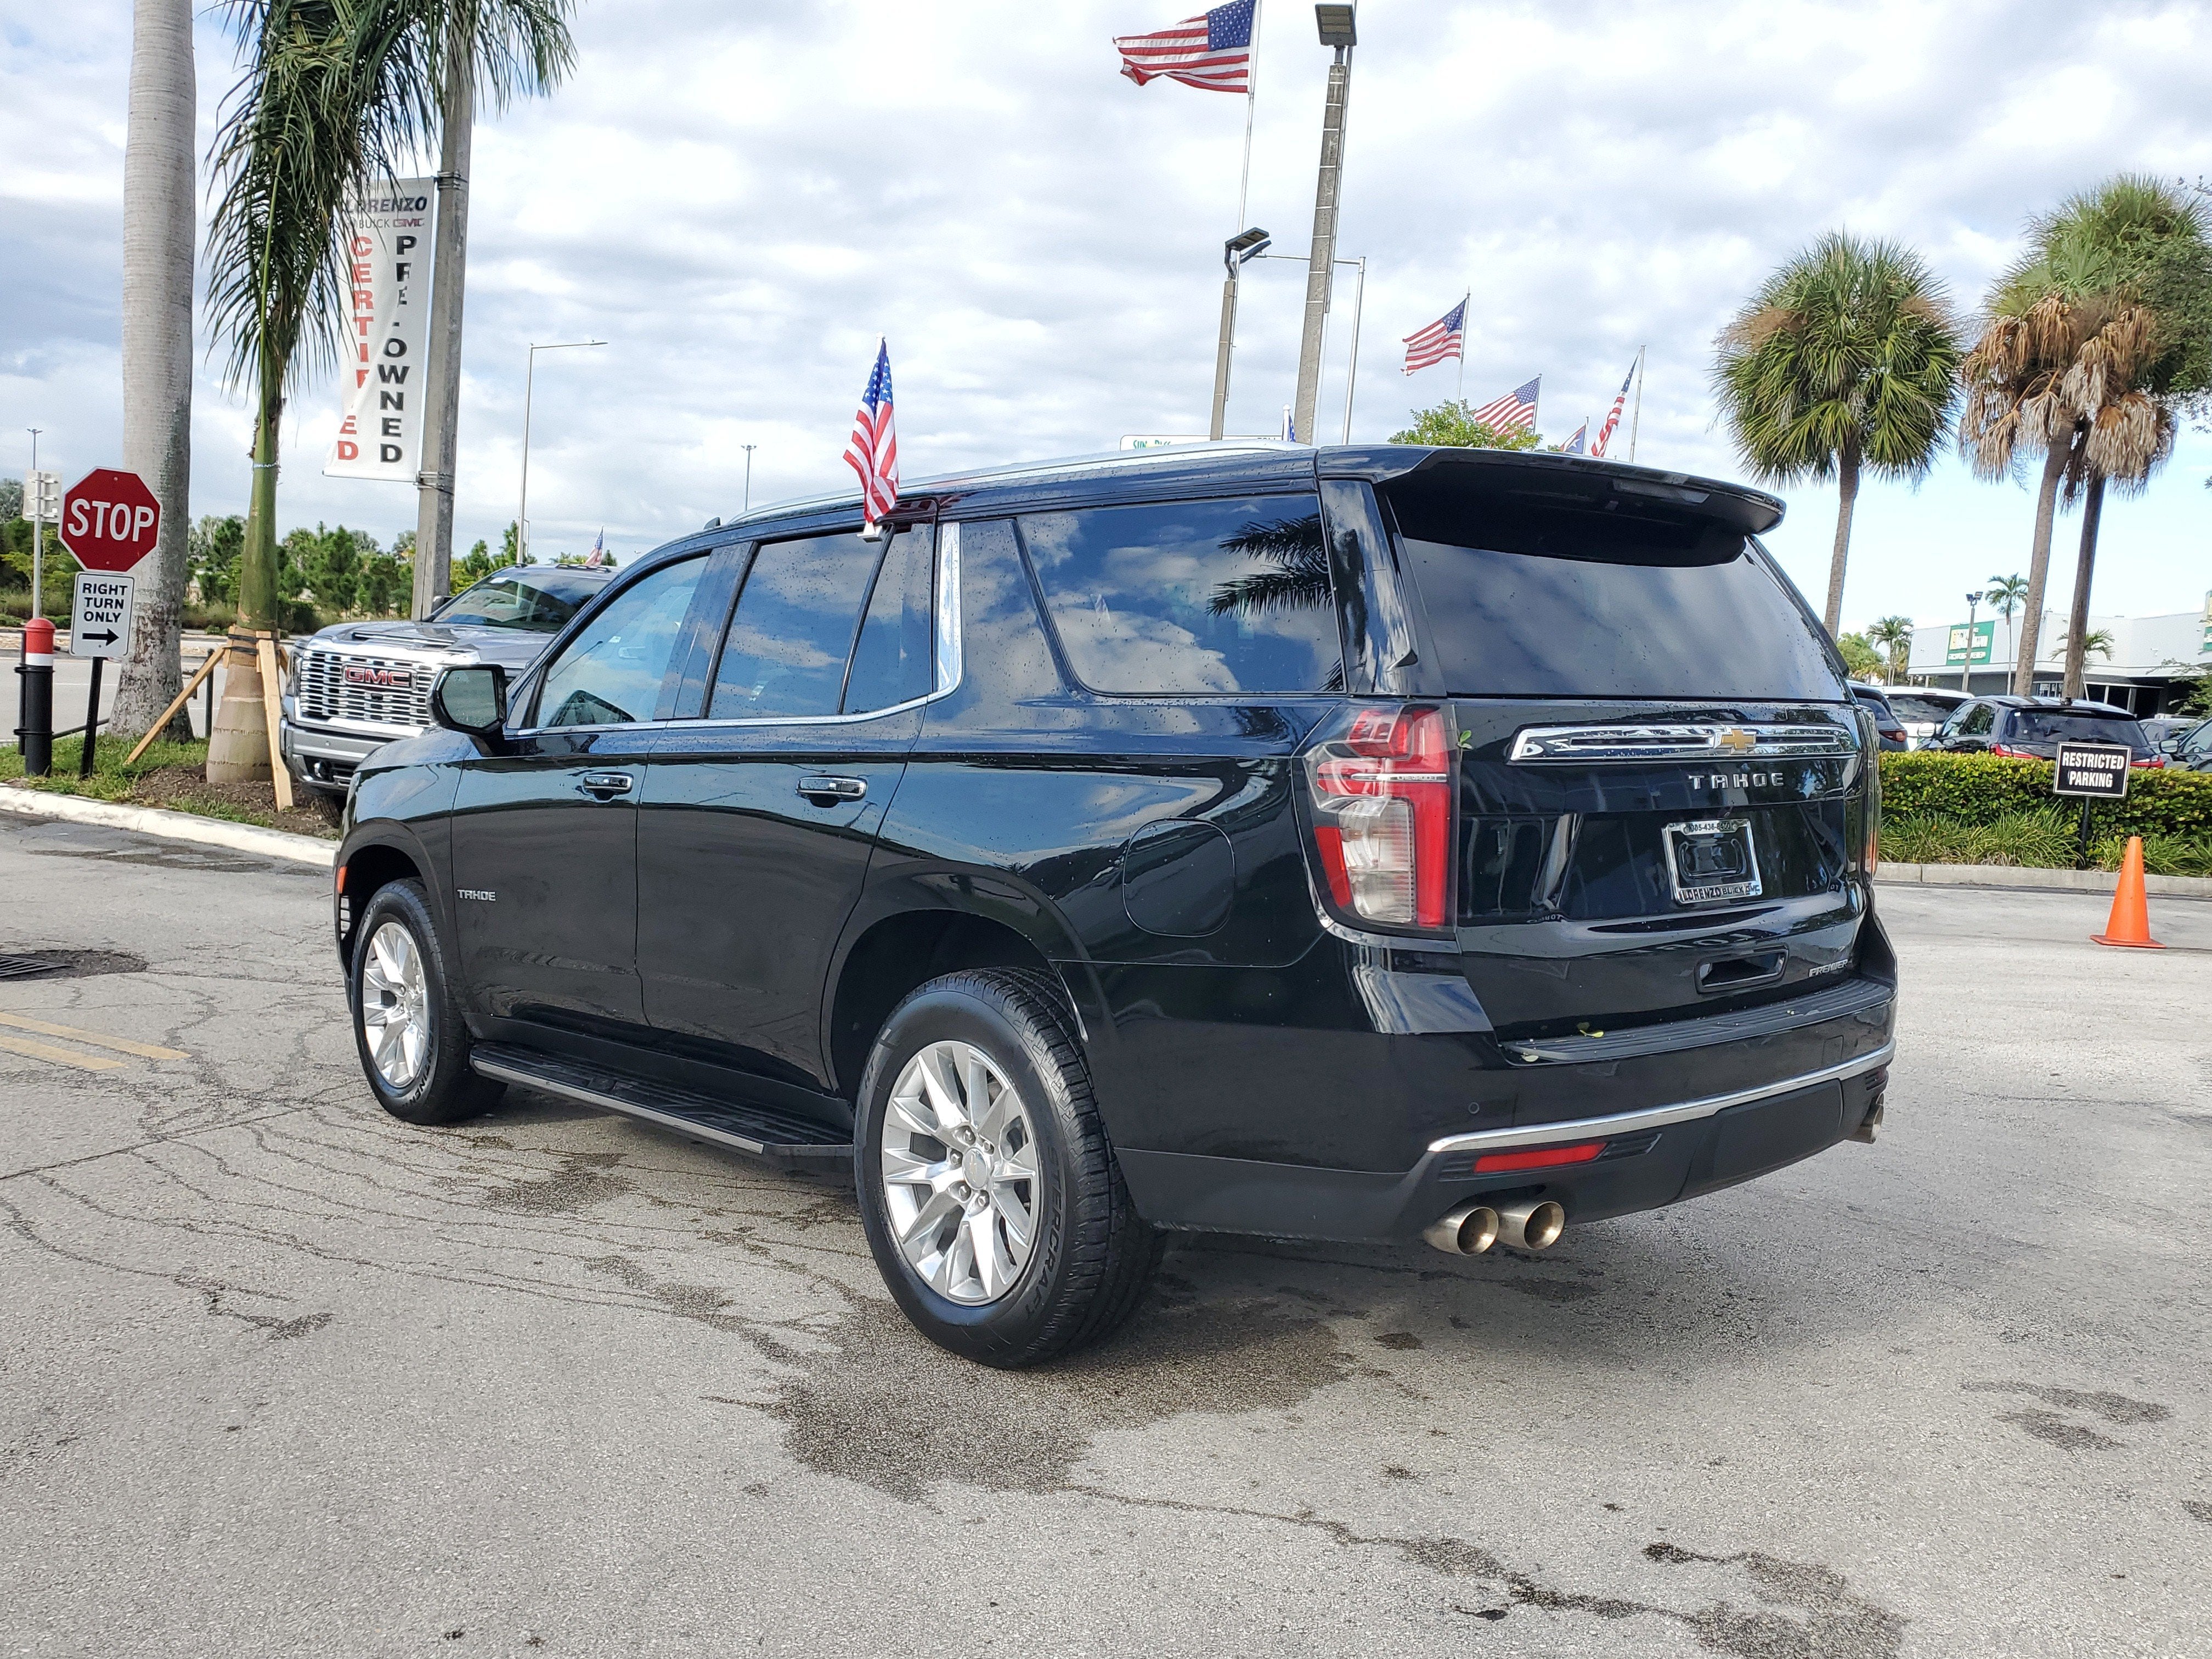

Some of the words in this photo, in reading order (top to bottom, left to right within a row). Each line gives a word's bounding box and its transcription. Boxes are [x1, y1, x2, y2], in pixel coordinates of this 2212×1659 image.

[337, 236, 374, 460] CERTIFED
[67, 498, 154, 542] STOP
[82, 583, 128, 596] RIGHT
[84, 597, 125, 609] TURN
[83, 611, 121, 623] ONLY
[345, 666, 410, 686] GMC
[2062, 752, 2125, 770] RESTRICTED
[1688, 772, 1784, 790] TAHOE
[2069, 770, 2113, 788] PARKING
[456, 889, 496, 901] TAHOE
[1681, 887, 1722, 901] LORENZO
[1722, 887, 1743, 895] BUICK
